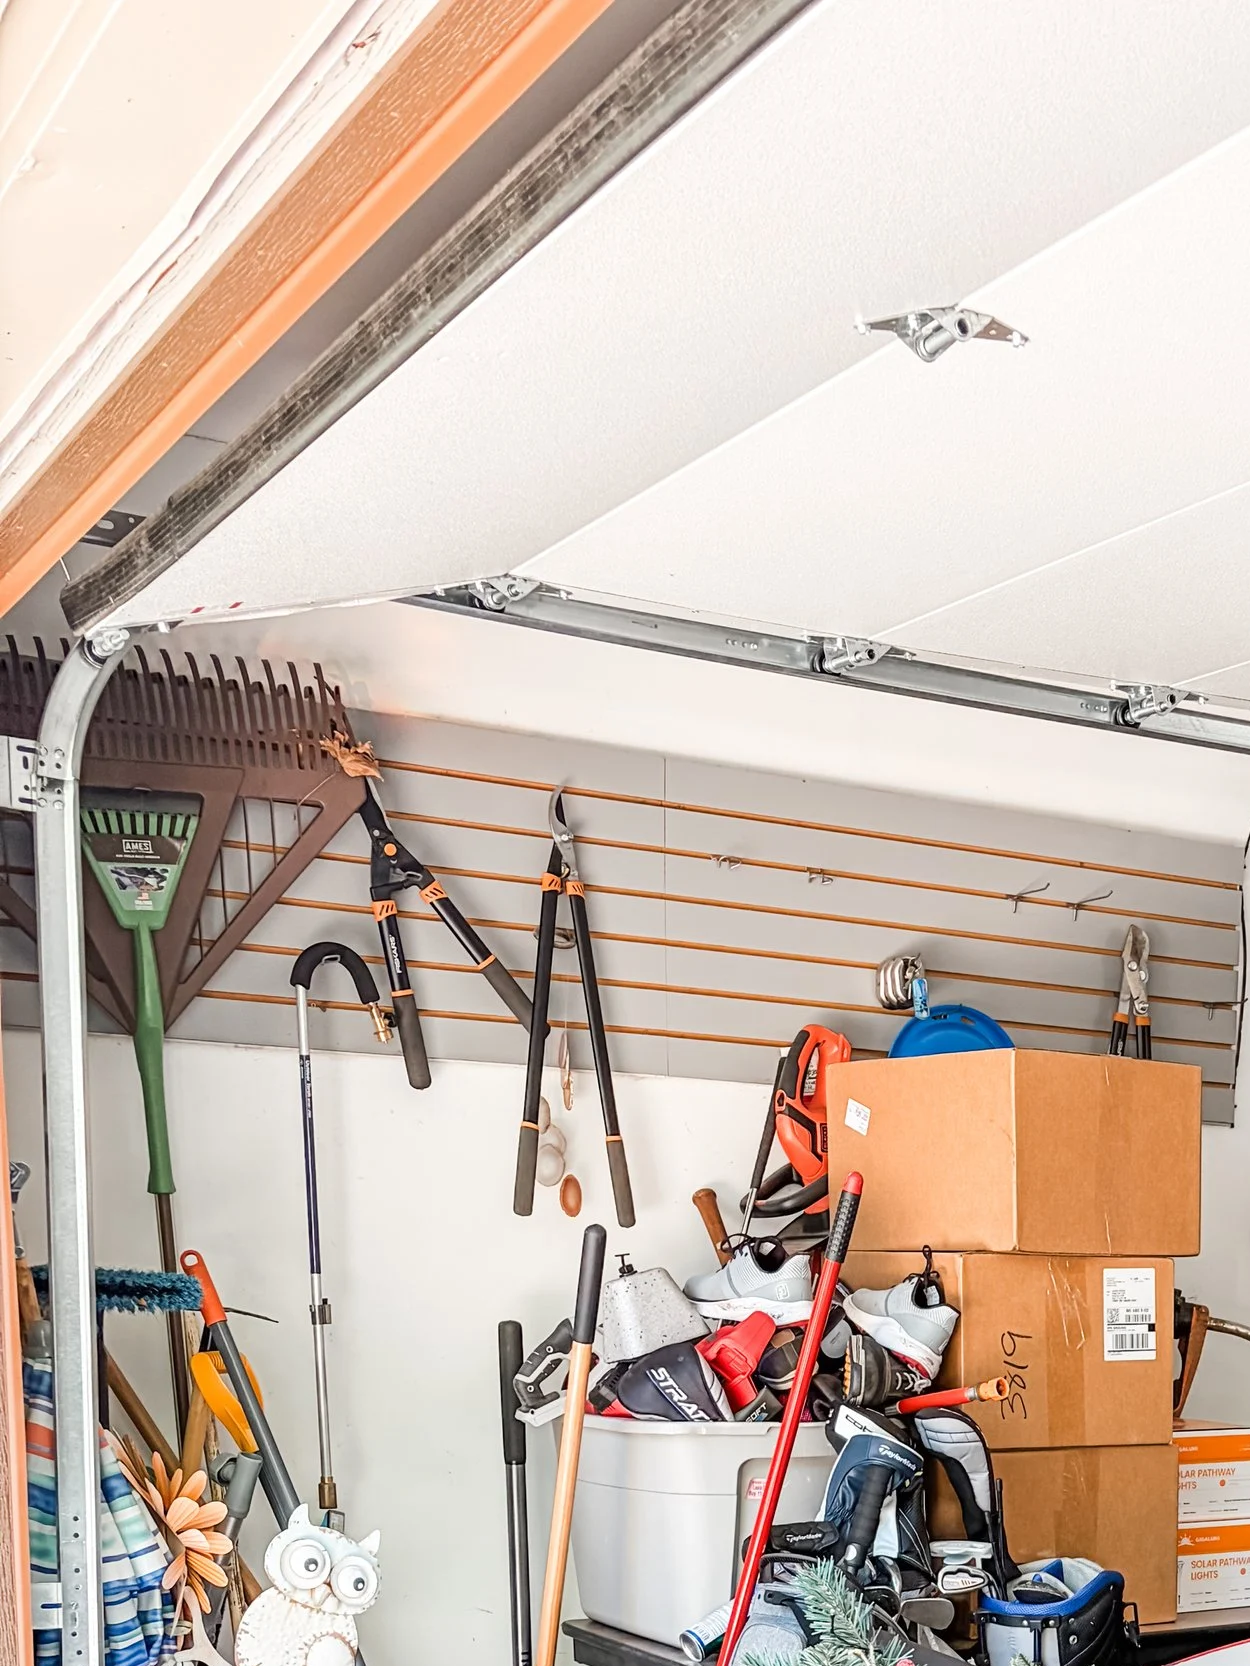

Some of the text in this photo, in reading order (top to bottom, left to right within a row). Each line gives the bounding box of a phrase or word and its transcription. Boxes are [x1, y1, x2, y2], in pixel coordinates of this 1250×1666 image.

[125, 842, 150, 851] AMES
[1178, 1468, 1236, 1479] LAR PATHWAY
[1191, 1560, 1218, 1569] SOLAR
[1190, 1570, 1219, 1580] LIGHTS
